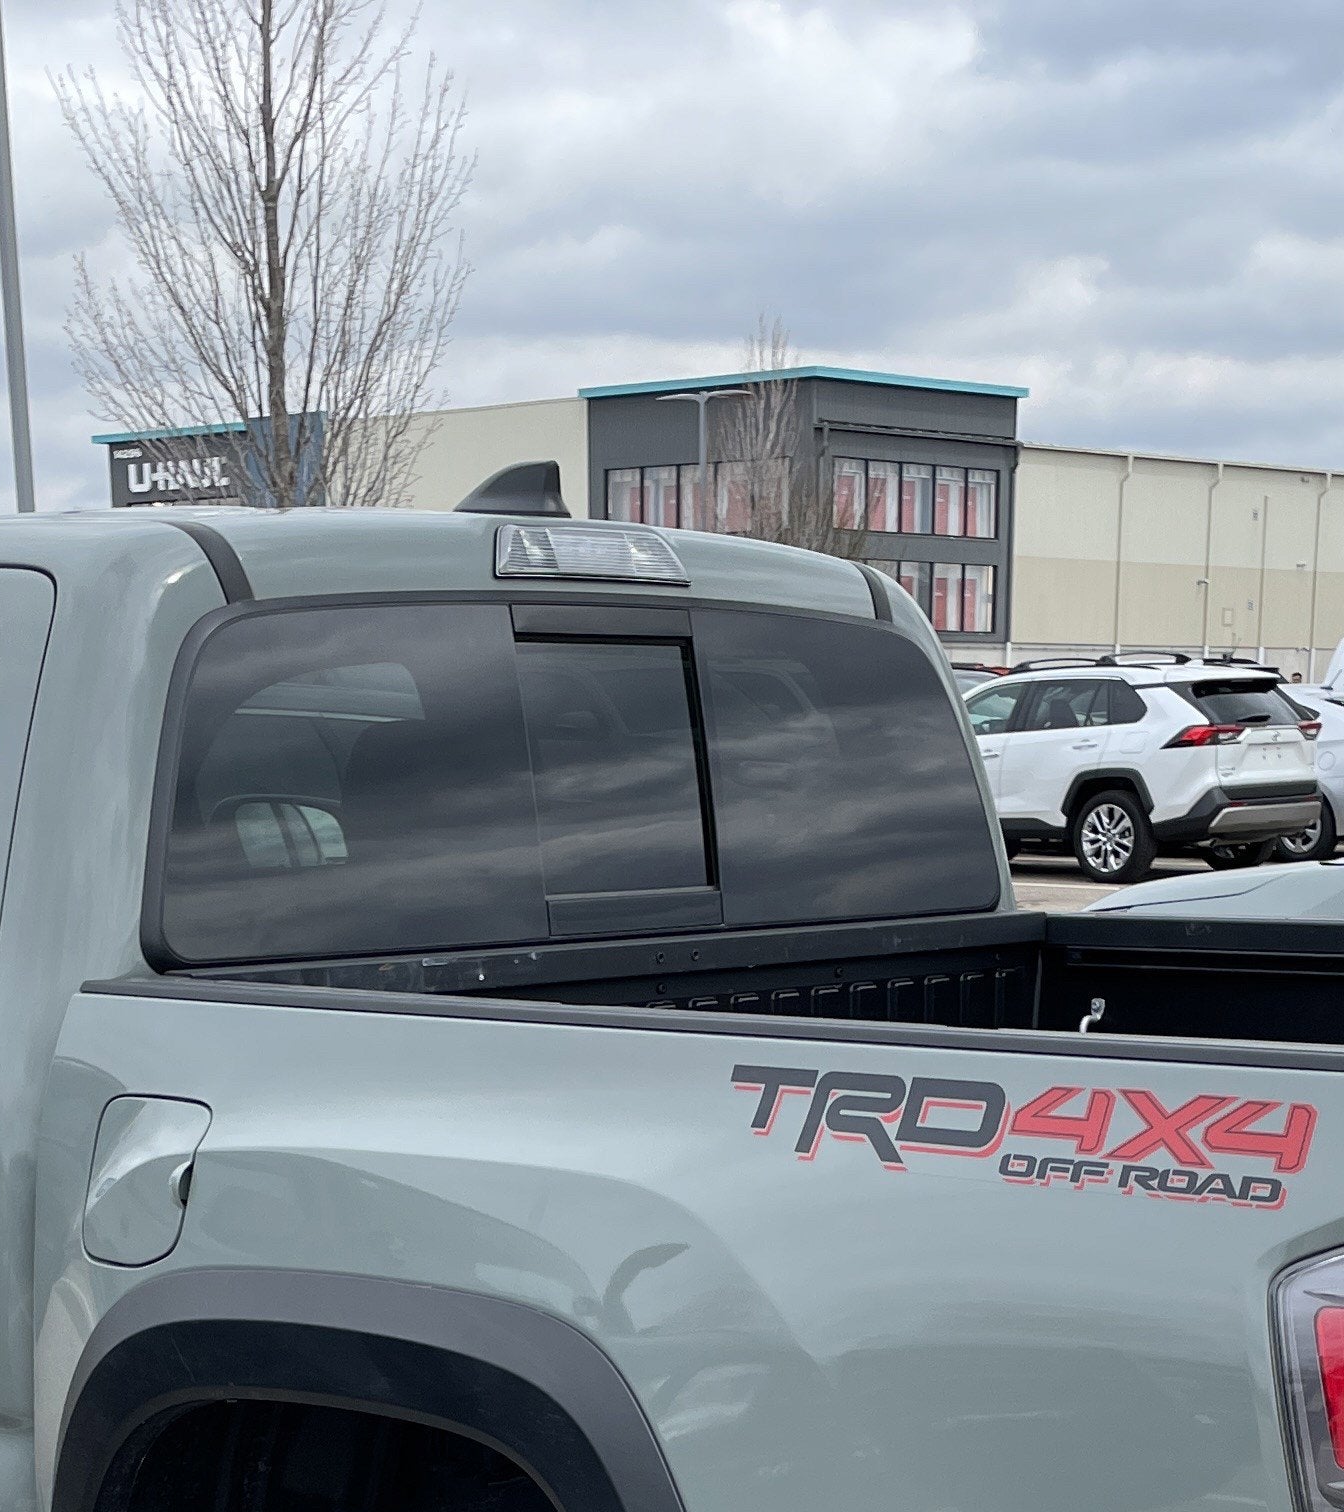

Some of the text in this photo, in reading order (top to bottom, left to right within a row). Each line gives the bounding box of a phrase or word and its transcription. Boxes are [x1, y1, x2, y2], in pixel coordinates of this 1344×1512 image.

[730, 1063, 1011, 1172] TRD
[997, 1151, 1288, 1211] OFF ROAD
